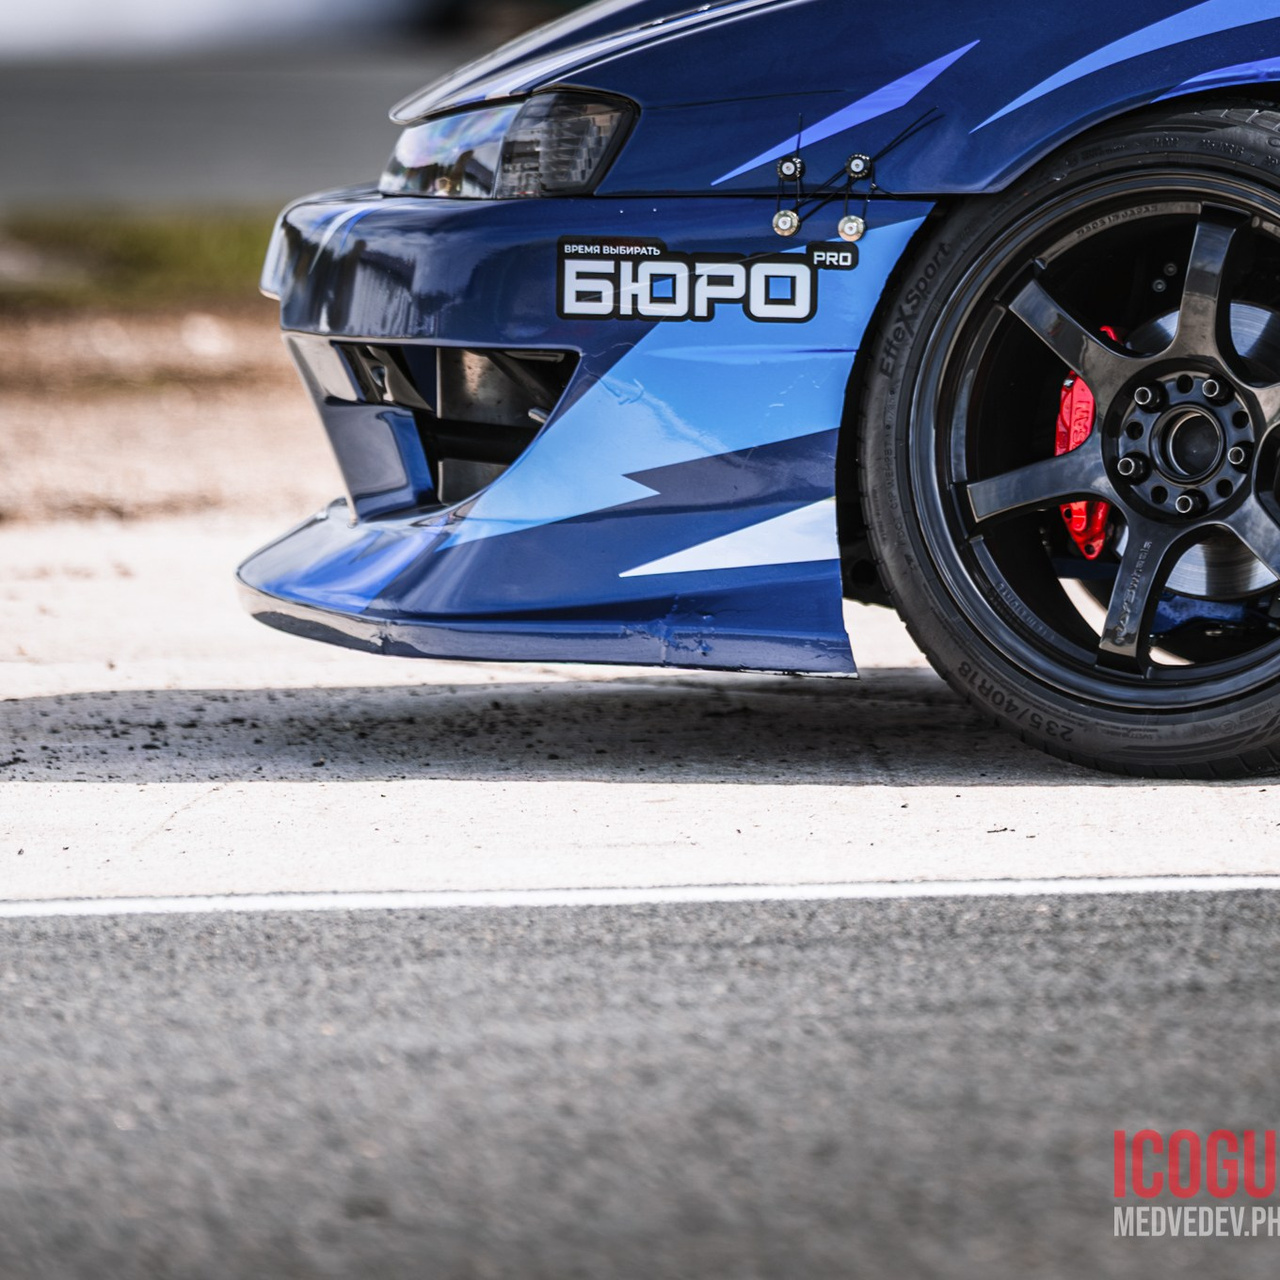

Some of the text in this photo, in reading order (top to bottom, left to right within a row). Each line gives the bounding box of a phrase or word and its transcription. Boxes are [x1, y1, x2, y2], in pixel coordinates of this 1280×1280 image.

[563, 244, 661, 257] ВРЕМЯ ВЫБИРАТЬ
[813, 250, 853, 267] PRO
[563, 258, 811, 319] БЮРО
[879, 241, 951, 379] EffeXSport
[957, 659, 1074, 742] 235/40R18
